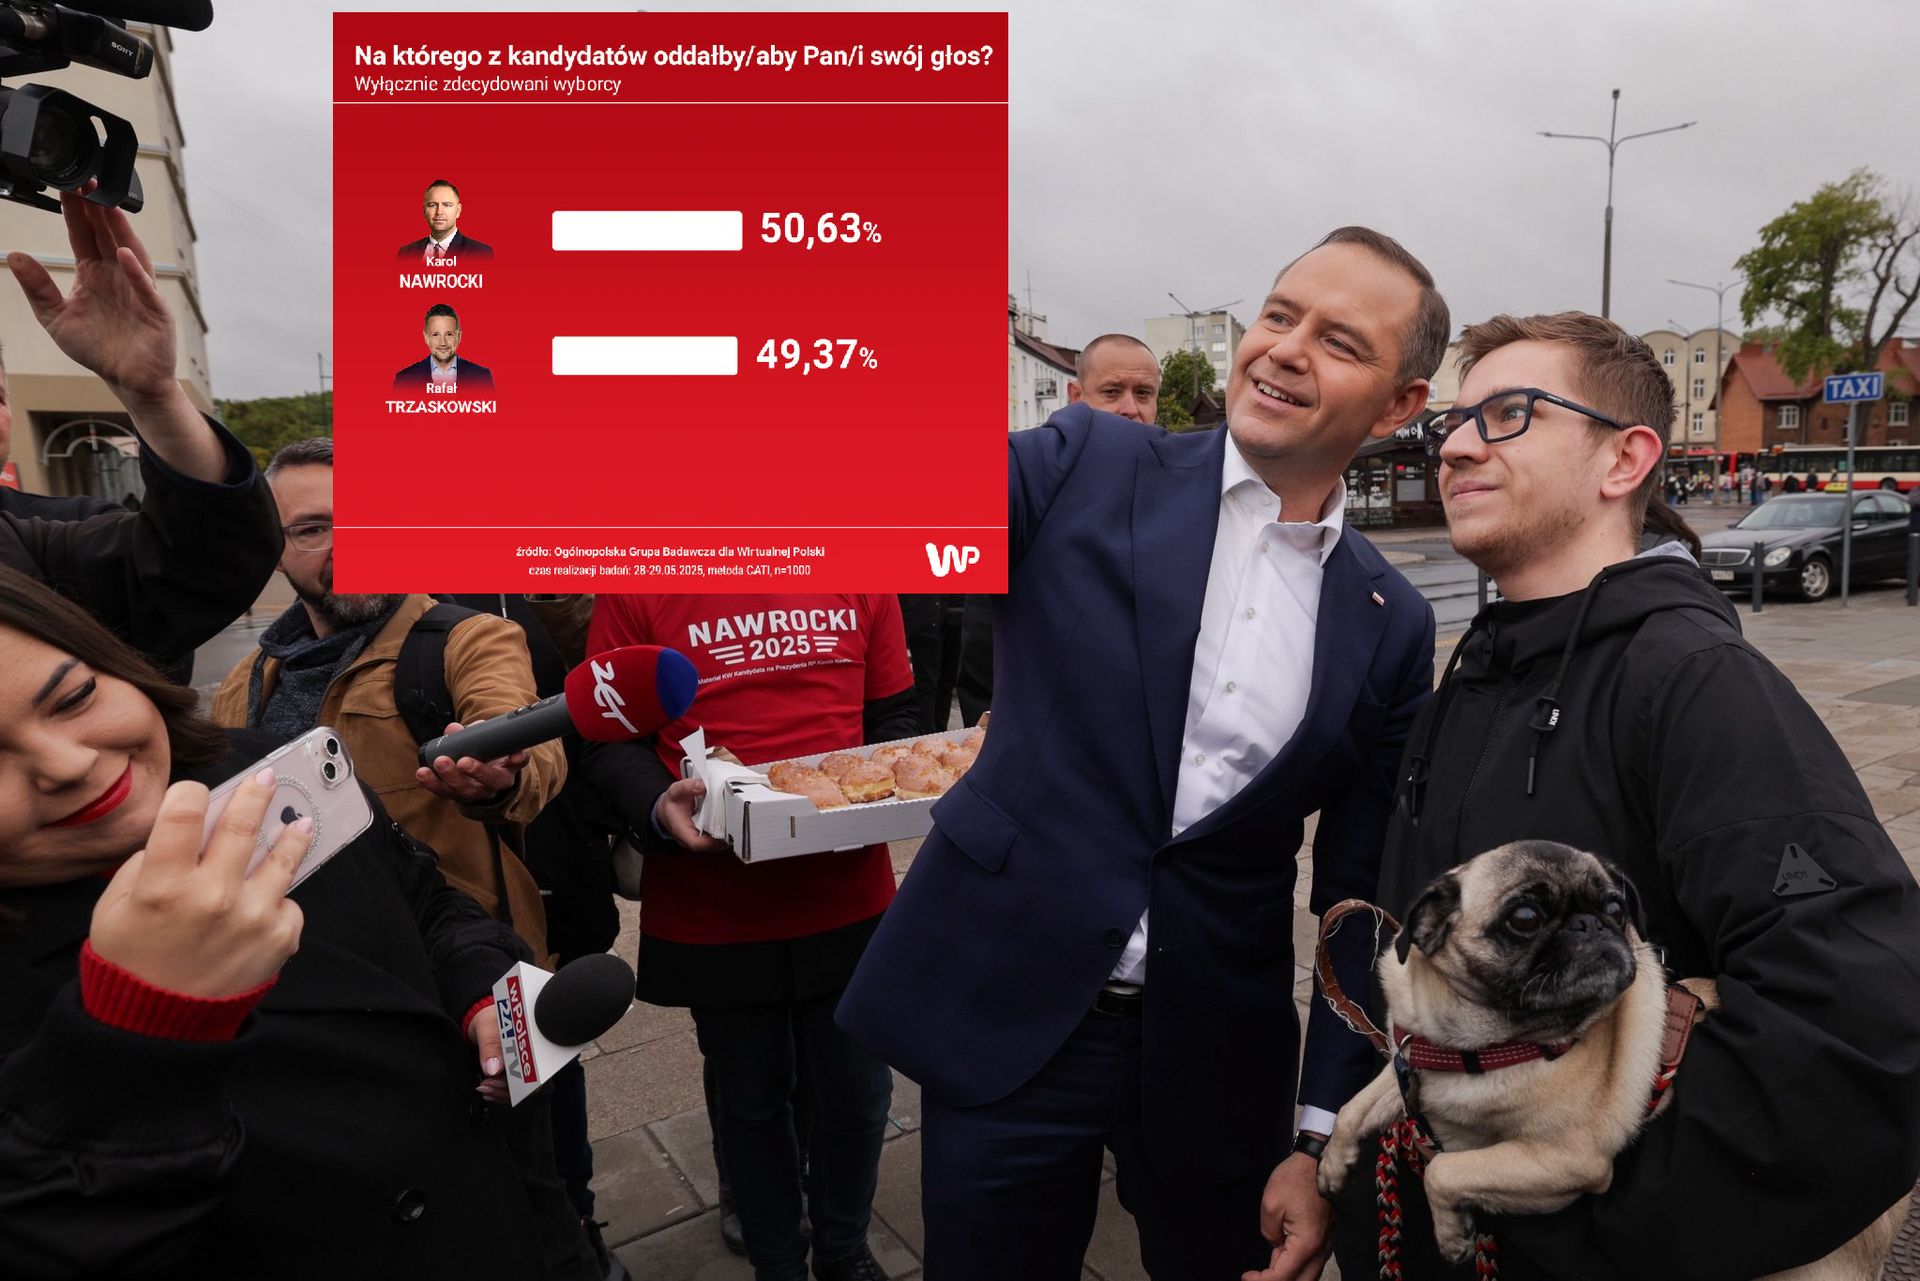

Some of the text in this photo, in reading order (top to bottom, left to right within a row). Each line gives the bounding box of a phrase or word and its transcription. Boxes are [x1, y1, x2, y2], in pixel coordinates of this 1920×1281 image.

[111, 41, 134, 57] SONY
[1828, 376, 1879, 399] TAXI
[688, 609, 857, 647] NAWROCKI
[749, 635, 811, 661] 2025
[722, 671, 733, 680] KW
[734, 667, 766, 678] Kandydata
[775, 661, 807, 672] Prezydenta
[509, 981, 532, 1077] wPolsce
[504, 1039, 523, 1080] TV
